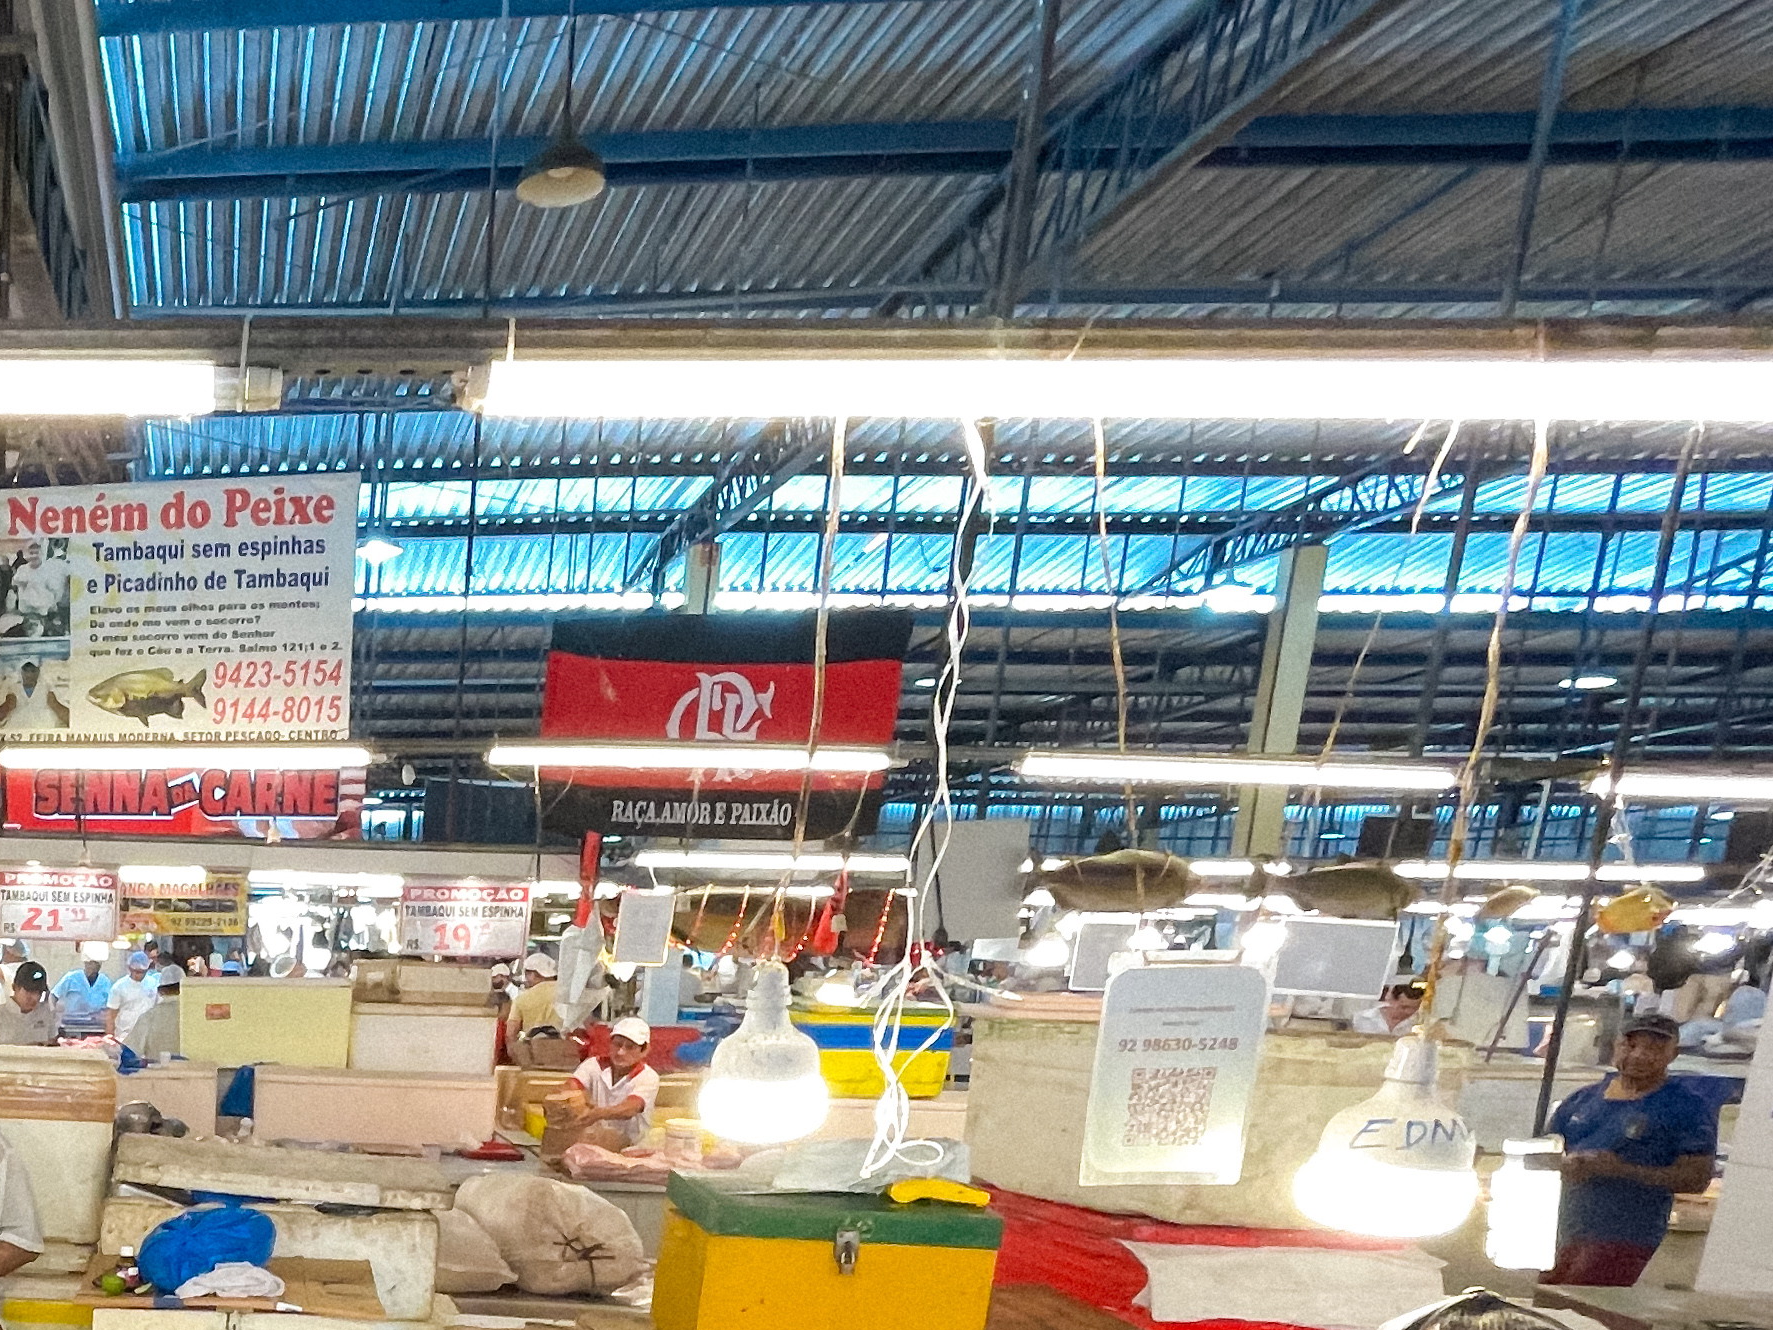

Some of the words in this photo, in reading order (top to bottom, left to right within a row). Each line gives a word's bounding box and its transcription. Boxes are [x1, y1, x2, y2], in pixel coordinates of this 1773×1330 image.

[7, 492, 149, 536] Neném
[160, 490, 212, 531] do
[223, 486, 336, 528] Peixe
[92, 540, 185, 565] Tambaqui
[191, 543, 231, 559] sem
[238, 535, 327, 564] espinhas
[86, 579, 98, 594] e
[105, 571, 198, 594] Picadinho
[204, 568, 227, 590] de
[234, 566, 330, 593] Tambaqui
[144, 605, 177, 613] meus
[218, 603, 246, 613] para
[250, 602, 265, 610] os
[89, 634, 98, 642] O
[132, 633, 179, 641] socorro
[231, 629, 276, 640] Senhor
[239, 643, 278, 653] Salmo
[212, 657, 344, 689] 9423-5154
[212, 694, 344, 725] 9144-8015
[28, 733, 62, 742] FEIRA
[66, 733, 115, 742] MANAUS
[184, 731, 221, 741] SETOR
[288, 729, 338, 740] CENTRO
[34, 768, 171, 816] SENNA
[198, 768, 339, 817] CARNE
[714, 801, 727, 825] E
[0, 889, 48, 901] TAMBAQUI
[51, 891, 70, 902] SEM
[73, 892, 114, 904] ESPINHA
[405, 904, 455, 917] TAMBAQUI
[459, 906, 478, 917] SEM
[481, 905, 524, 918] ESPINHA
[1117, 1039, 1138, 1052] 92
[1141, 1037, 1239, 1051] 98630-5248
